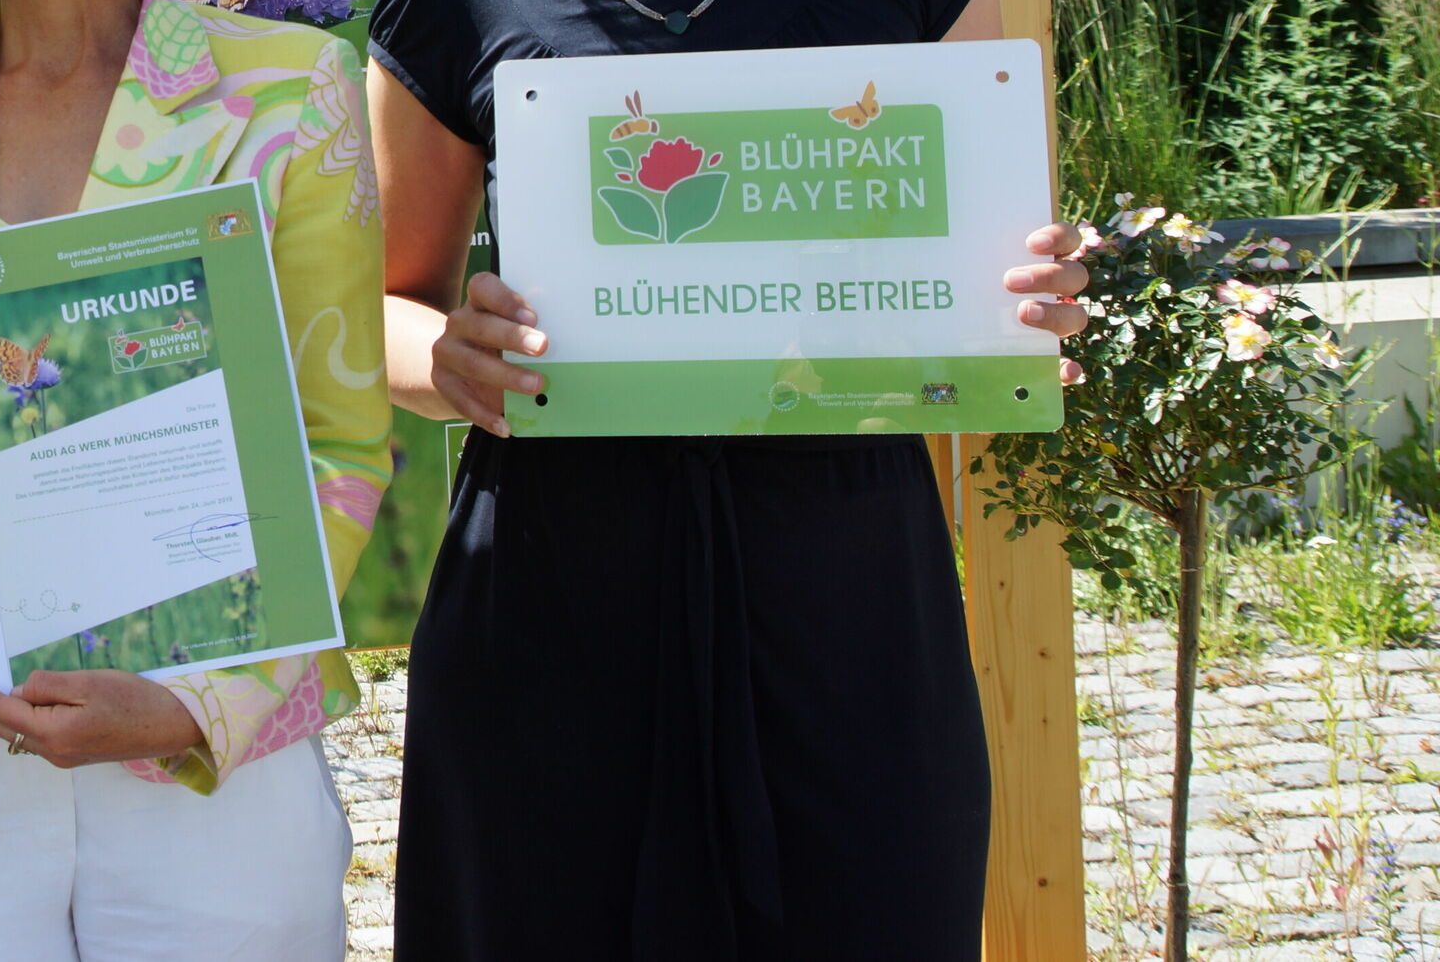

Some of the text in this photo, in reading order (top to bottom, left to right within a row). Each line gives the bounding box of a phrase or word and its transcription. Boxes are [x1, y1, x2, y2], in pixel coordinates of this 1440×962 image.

[740, 134, 926, 171] BLÜHPAKT
[742, 178, 927, 213] BAYERN
[57, 227, 199, 261] Bayerisches Staatsministerium für
[71, 237, 201, 268] Umwelt und Verbraucherschutz
[61, 279, 198, 324] URKUNDE
[594, 280, 954, 316] BLÜHENDER BETRIEB
[149, 328, 198, 347] BLÜHPAKT
[152, 341, 201, 358] BAYERN
[30, 418, 220, 461] AUDI AG WERK MÜNCHSMÜNSTER
